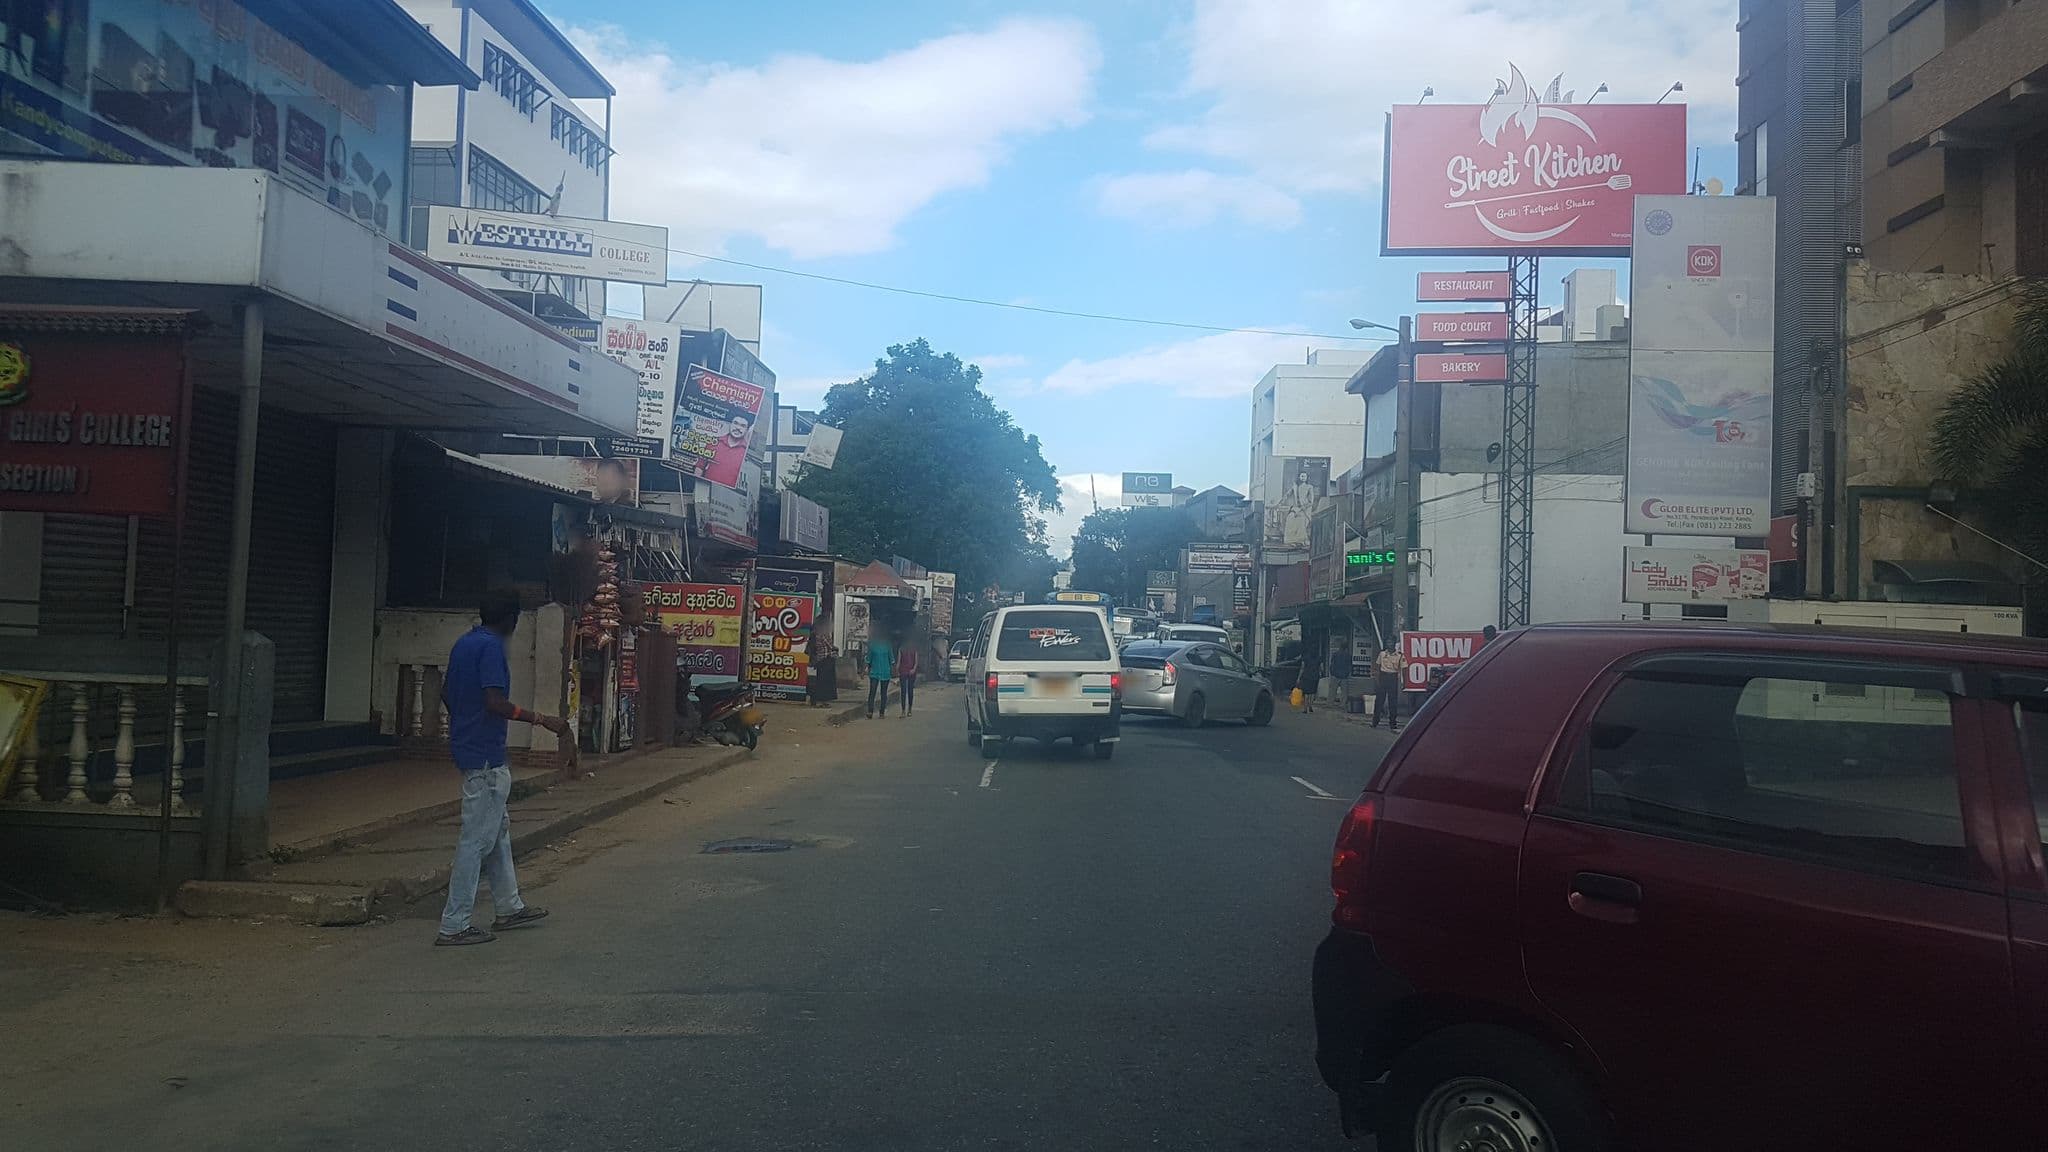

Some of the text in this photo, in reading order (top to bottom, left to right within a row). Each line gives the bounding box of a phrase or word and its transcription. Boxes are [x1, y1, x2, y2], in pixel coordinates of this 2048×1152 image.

[1447, 142, 1622, 198] Street Kitchen
[1496, 199, 1596, 220] Grill Fastfood Shakes
[448, 211, 650, 263] WESTHILL COLLEGE
[1694, 255, 1714, 266] KDK
[1433, 280, 1494, 291] RESTAURANT
[1432, 322, 1492, 332] FOOD COURT
[1442, 362, 1480, 373] BAKERY
[702, 376, 759, 405] Chemistry
[80, 412, 172, 448] COLLEGE
[0, 464, 79, 495] SECTION
[1686, 506, 1709, 514] ELITE
[1711, 507, 1734, 515] (PVT)
[1631, 561, 1667, 578] Lady
[1647, 574, 1687, 587] Smith
[775, 638, 790, 650] 07
[1411, 637, 1472, 659] NOW
